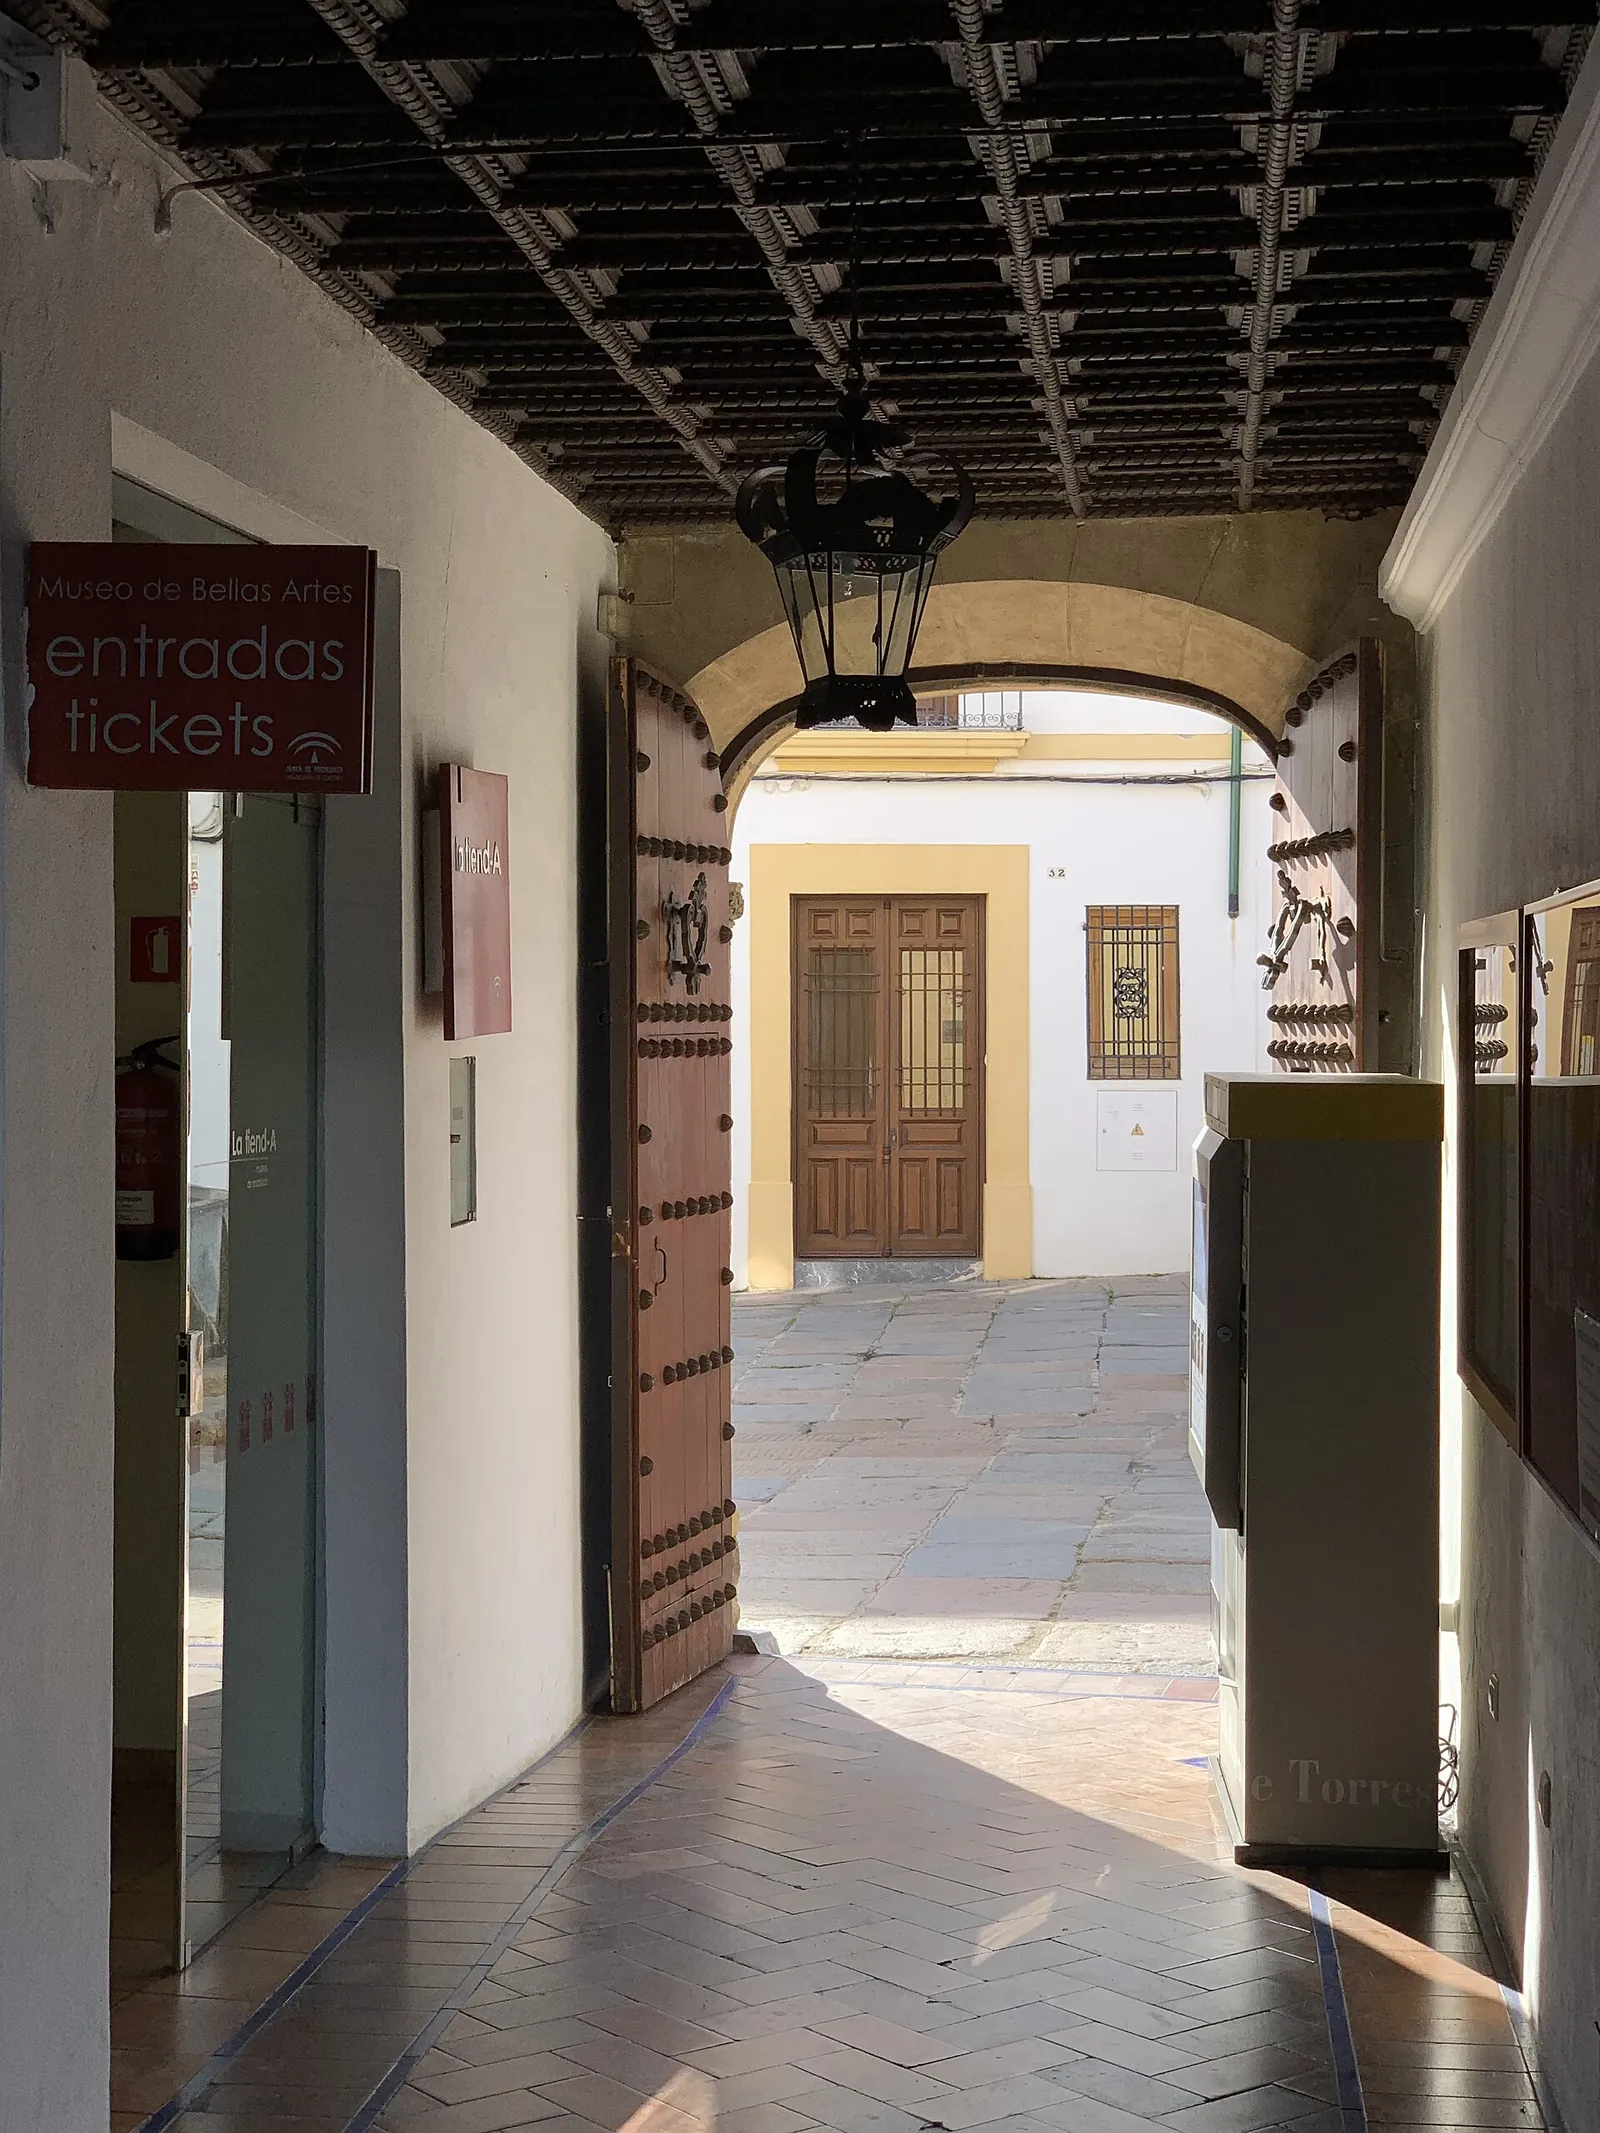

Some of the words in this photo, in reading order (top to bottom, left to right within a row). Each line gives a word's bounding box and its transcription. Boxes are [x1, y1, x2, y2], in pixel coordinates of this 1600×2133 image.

[38, 576, 133, 601] Museo
[143, 577, 181, 601] de
[192, 577, 272, 602] Bellas
[281, 578, 353, 603] Artes
[46, 624, 344, 681] entradas
[65, 698, 275, 756] tickets
[232, 1130, 243, 1156] La
